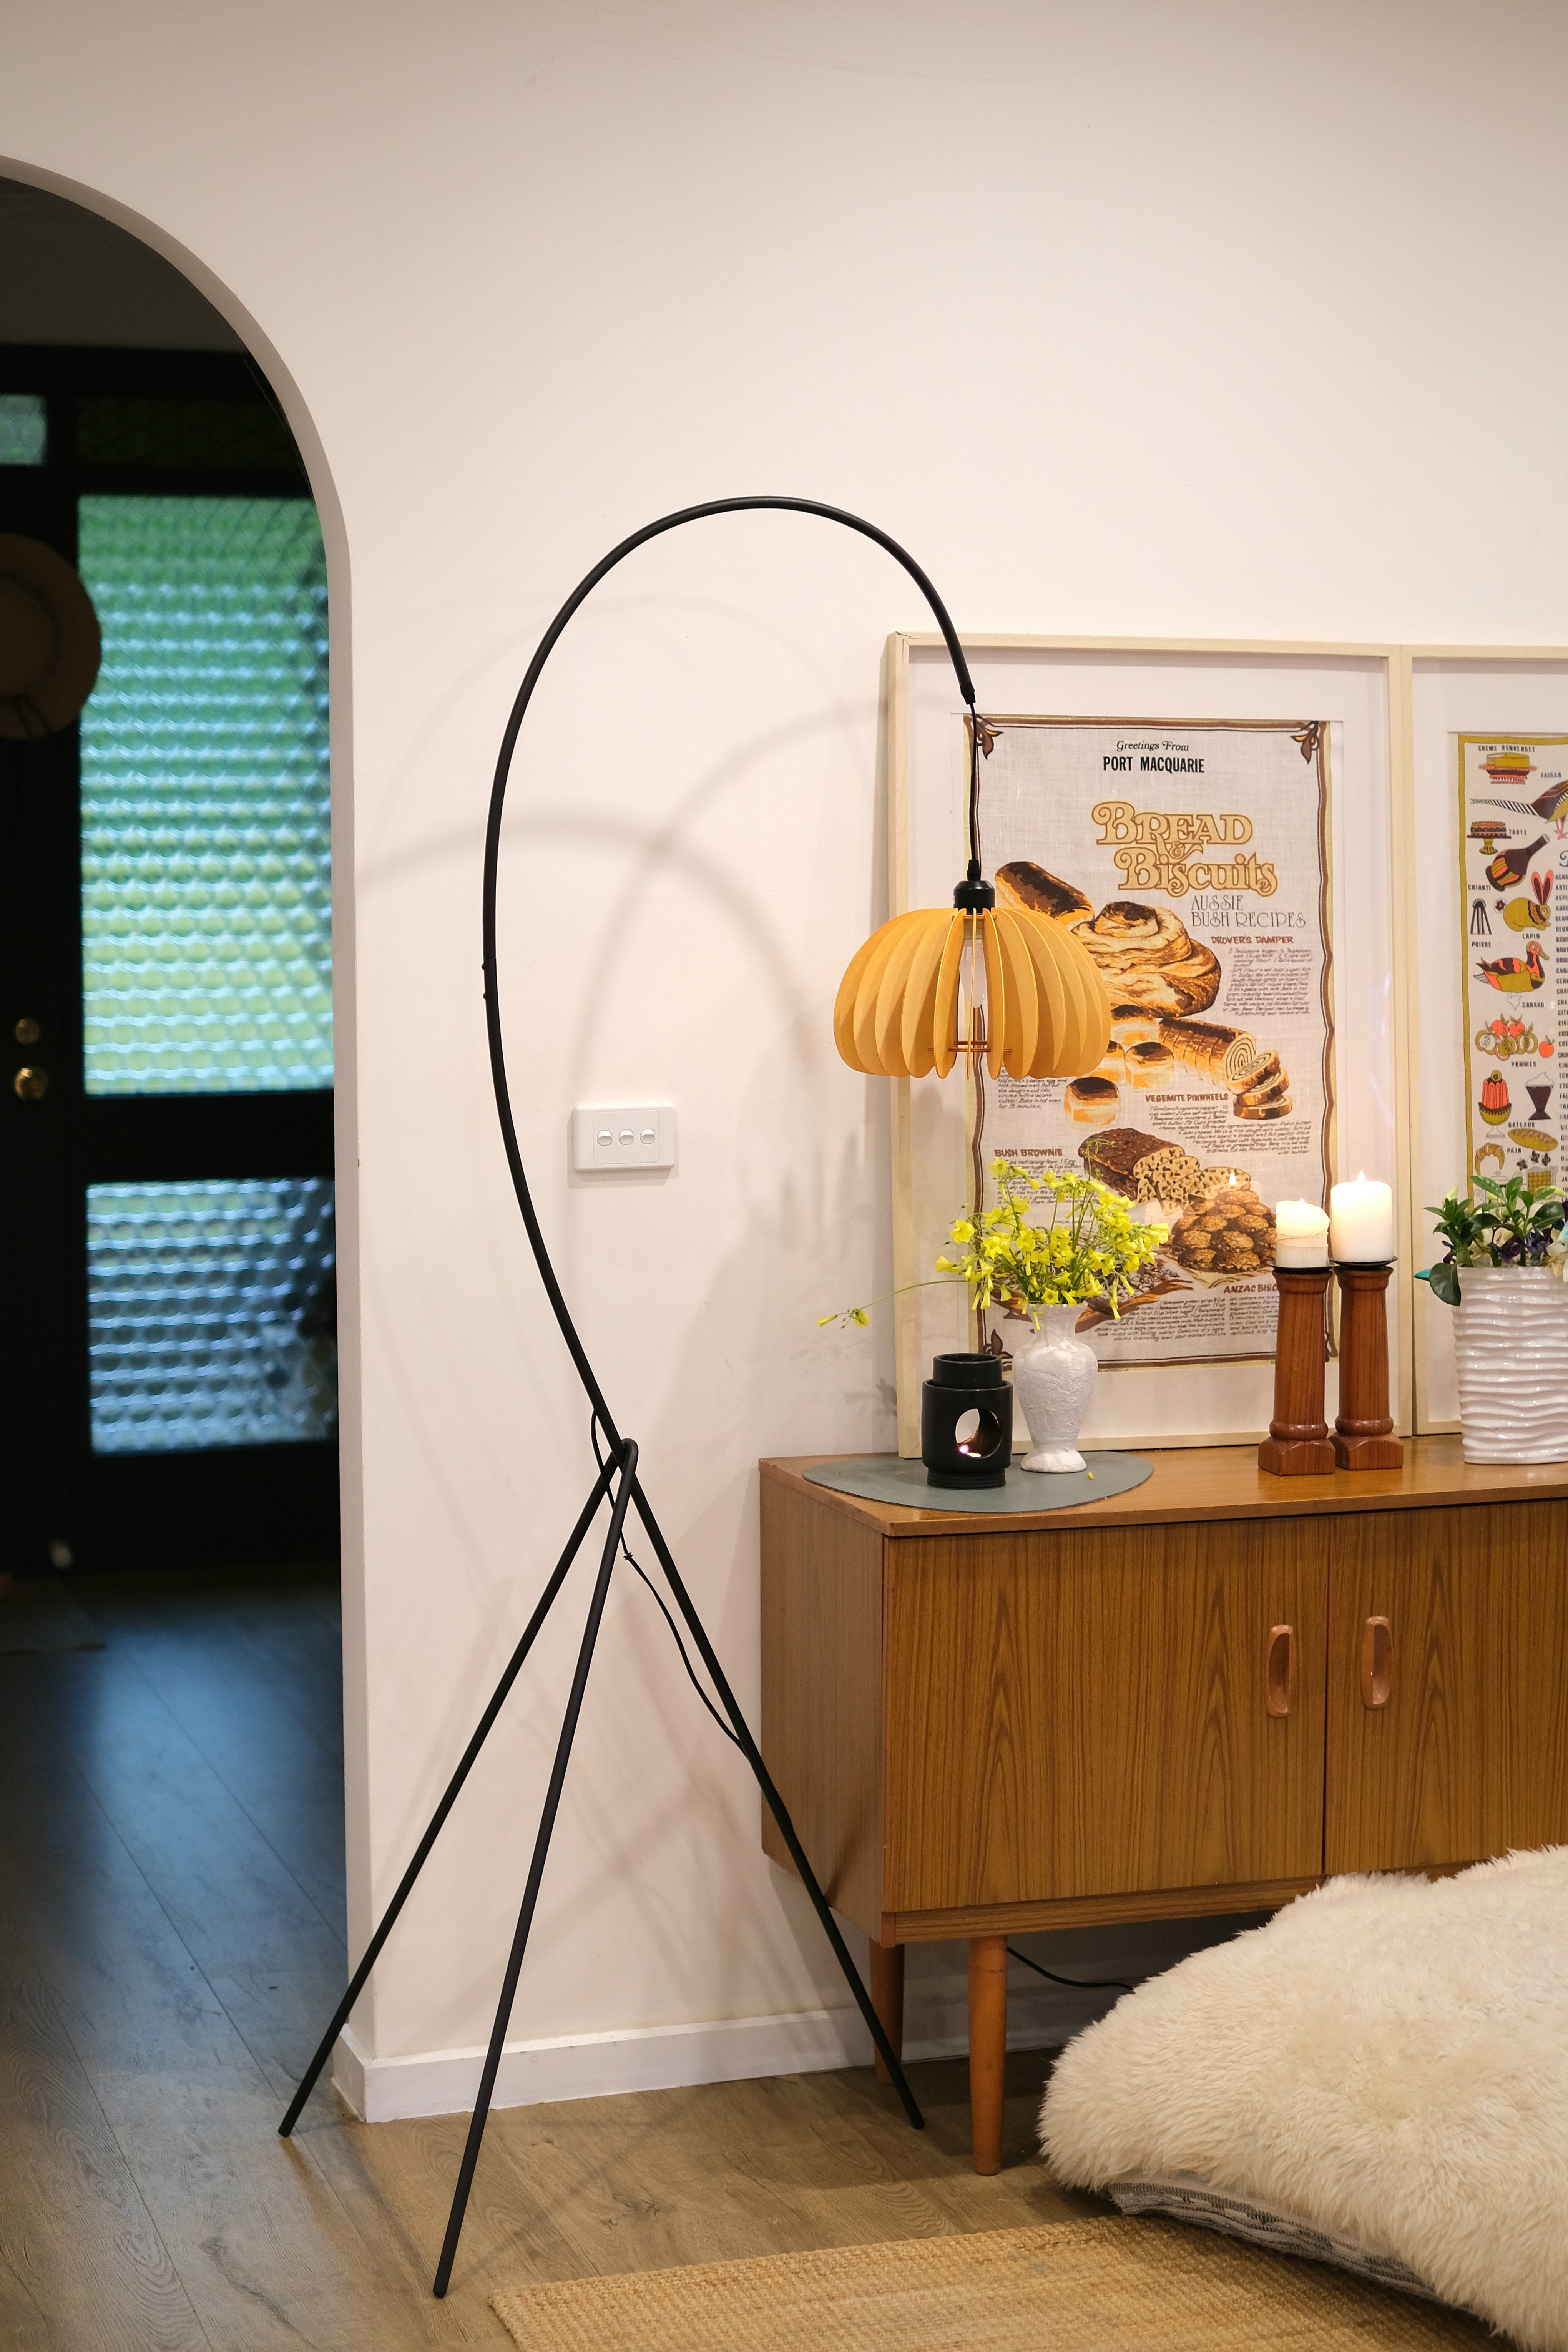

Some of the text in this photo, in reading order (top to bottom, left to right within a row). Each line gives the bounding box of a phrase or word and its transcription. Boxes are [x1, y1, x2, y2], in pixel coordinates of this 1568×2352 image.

[1116, 740, 1189, 752] Greetings From
[1103, 756, 1204, 774] PORT MACQUARIE
[1091, 801, 1254, 847] BREAD
[1114, 847, 1278, 898] Biscuits
[1191, 895, 1244, 911] AUSSIE
[1191, 912, 1306, 928] BUSH RECIPES
[1211, 935, 1294, 945] DROVER'S DAMPER
[1187, 1093, 1229, 1102] PINWHEELS
[994, 1148, 1063, 1157] BUSH BROWNIE
[1224, 1284, 1256, 1294] ANZAC
